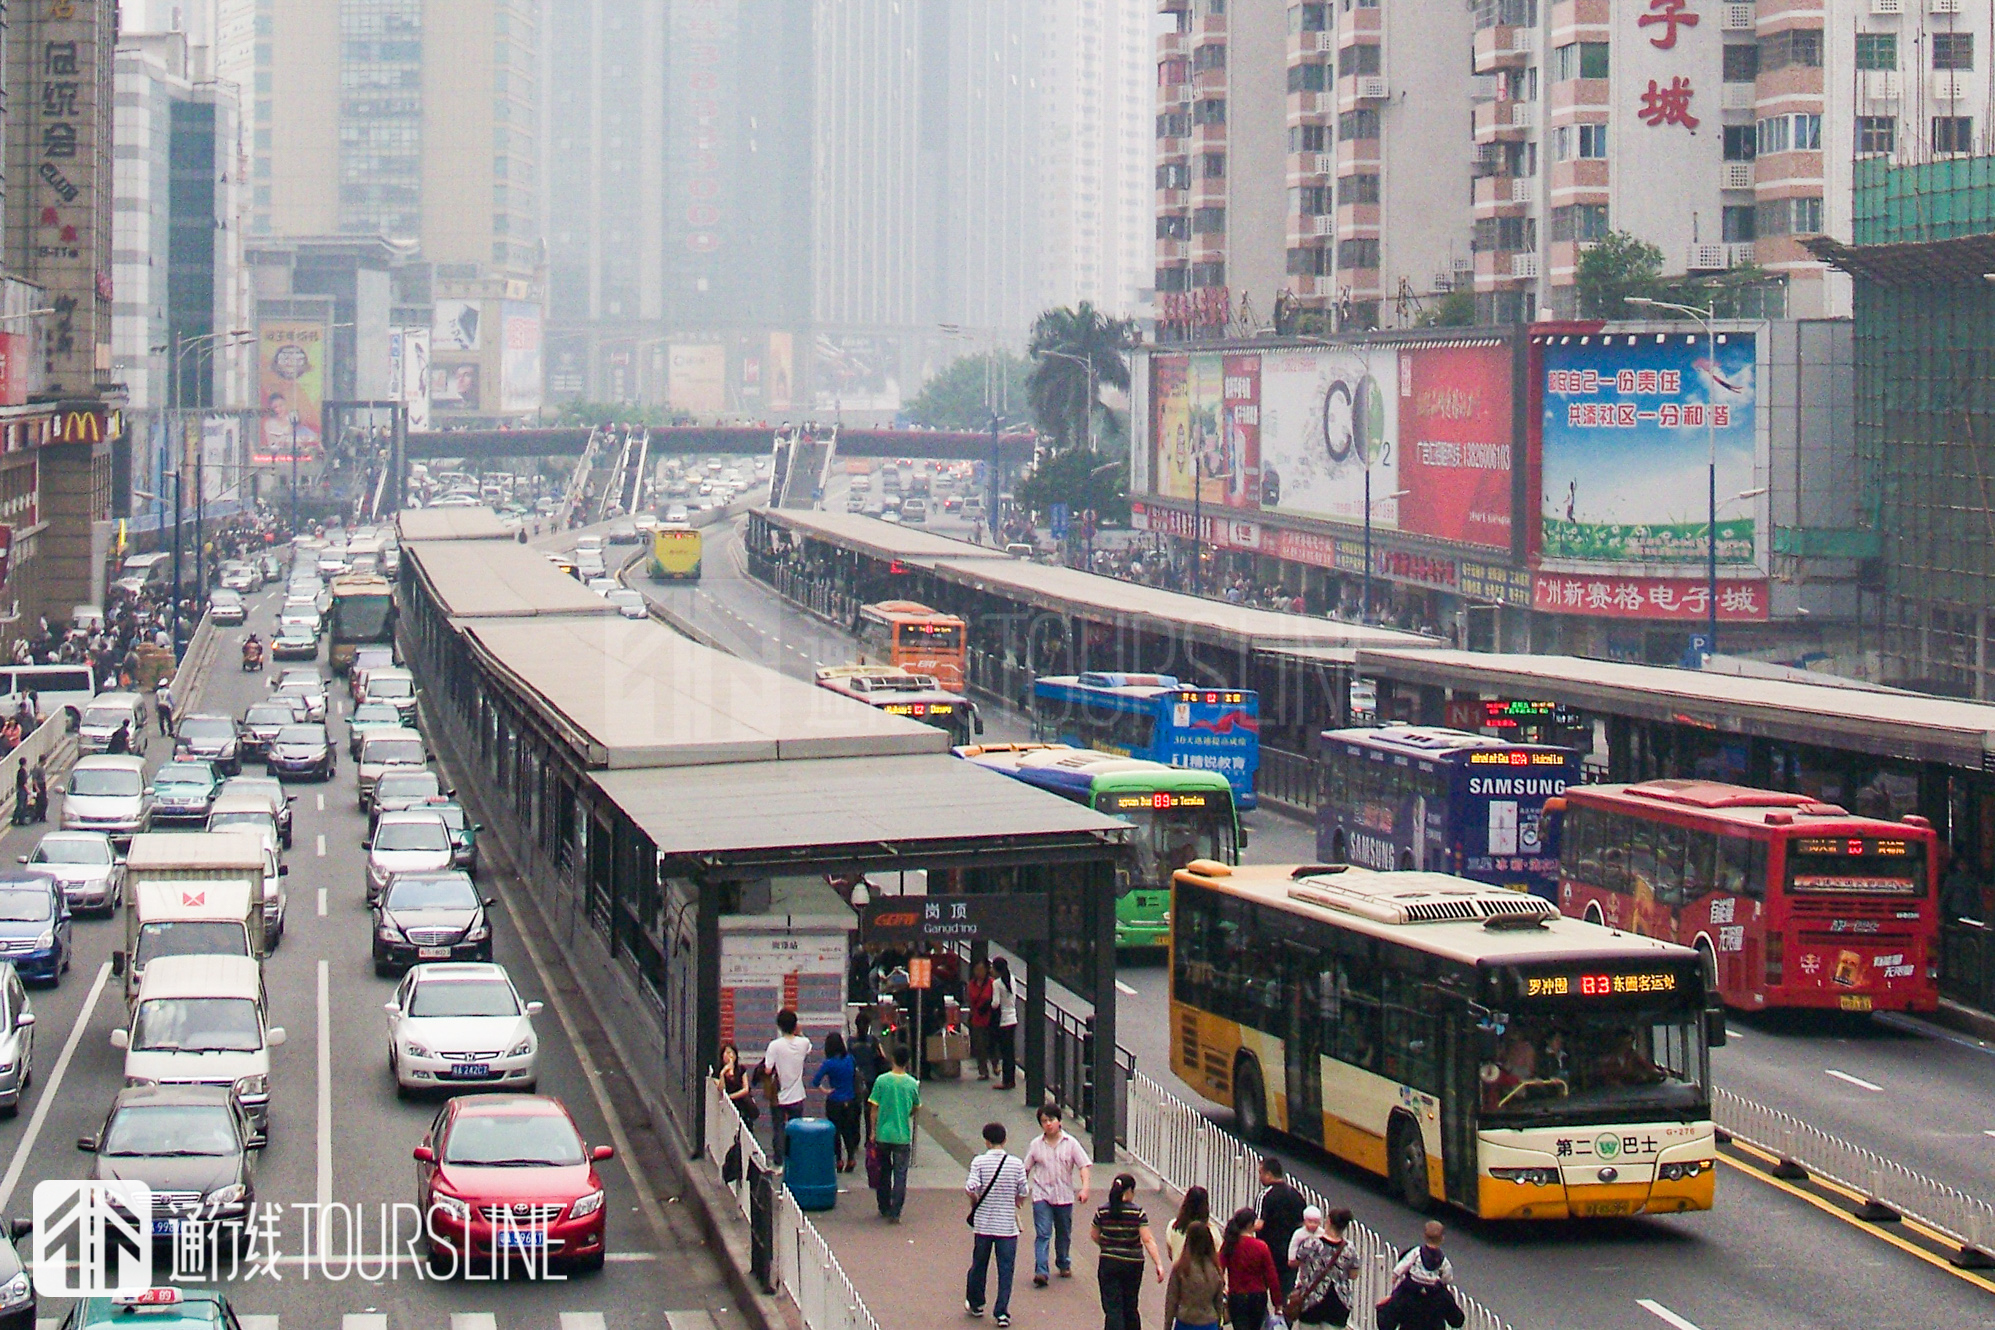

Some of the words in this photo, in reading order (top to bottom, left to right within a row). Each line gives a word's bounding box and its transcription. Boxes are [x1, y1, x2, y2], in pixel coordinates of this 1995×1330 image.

[1535, 577, 1759, 613] 广州新赛格电子城
[1693, 637, 1705, 651] P
[1469, 777, 1566, 795] SAMSUNG
[1350, 831, 1395, 871] SAMSUNG
[925, 902, 968, 919] 岗顶
[923, 923, 978, 934] Gangding
[1556, 1138, 1593, 1158] 第二
[1622, 1135, 1658, 1154] 巴士
